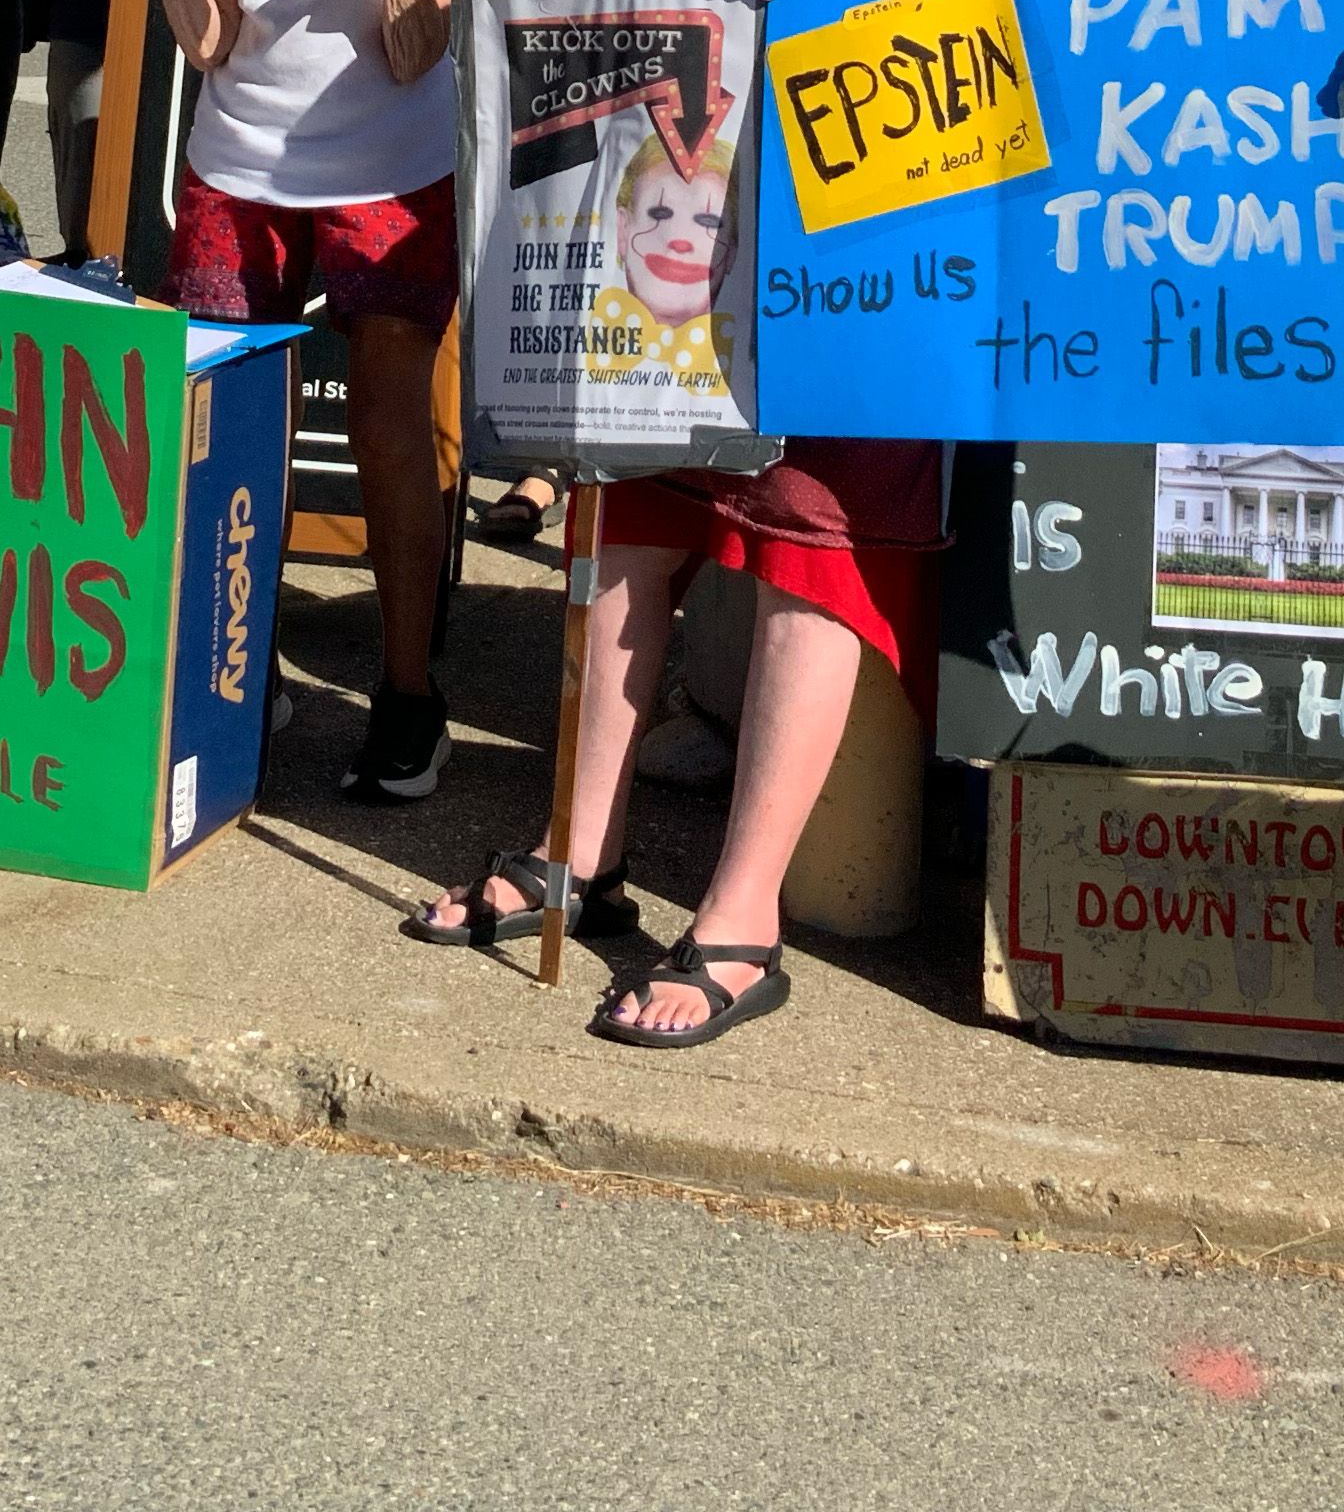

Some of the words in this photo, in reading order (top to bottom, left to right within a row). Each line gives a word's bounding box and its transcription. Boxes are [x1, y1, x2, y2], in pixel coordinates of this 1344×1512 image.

[853, 0, 903, 21] Epstein
[522, 29, 605, 53] KICK
[613, 29, 683, 53] OUT
[531, 55, 665, 118] CLOWNS
[543, 59, 567, 85] the
[786, 18, 1020, 186] EPSTEIN
[906, 156, 931, 181] not
[939, 135, 984, 176] dead
[995, 121, 1032, 159] yet
[514, 240, 558, 273] JOIN
[566, 240, 605, 270] THE
[511, 283, 542, 313] BIG
[549, 283, 600, 312] TENT
[509, 325, 643, 356] RESISTANCE
[975, 299, 1100, 390] the
[503, 367, 522, 385] END
[523, 367, 537, 385] THE
[540, 368, 584, 386] GREATEST
[587, 368, 651, 387] SHITSHOW
[654, 370, 674, 387] ON
[677, 371, 722, 389] EARTH!
[614, 406, 626, 414] for
[628, 407, 660, 417] control,
[664, 408, 687, 417] we're
[689, 408, 722, 420] hosting
[215, 519, 224, 568] where
[219, 486, 256, 704] chewy
[212, 601, 222, 651] lovers
[209, 653, 219, 694] shop
[985, 627, 1265, 719] White
